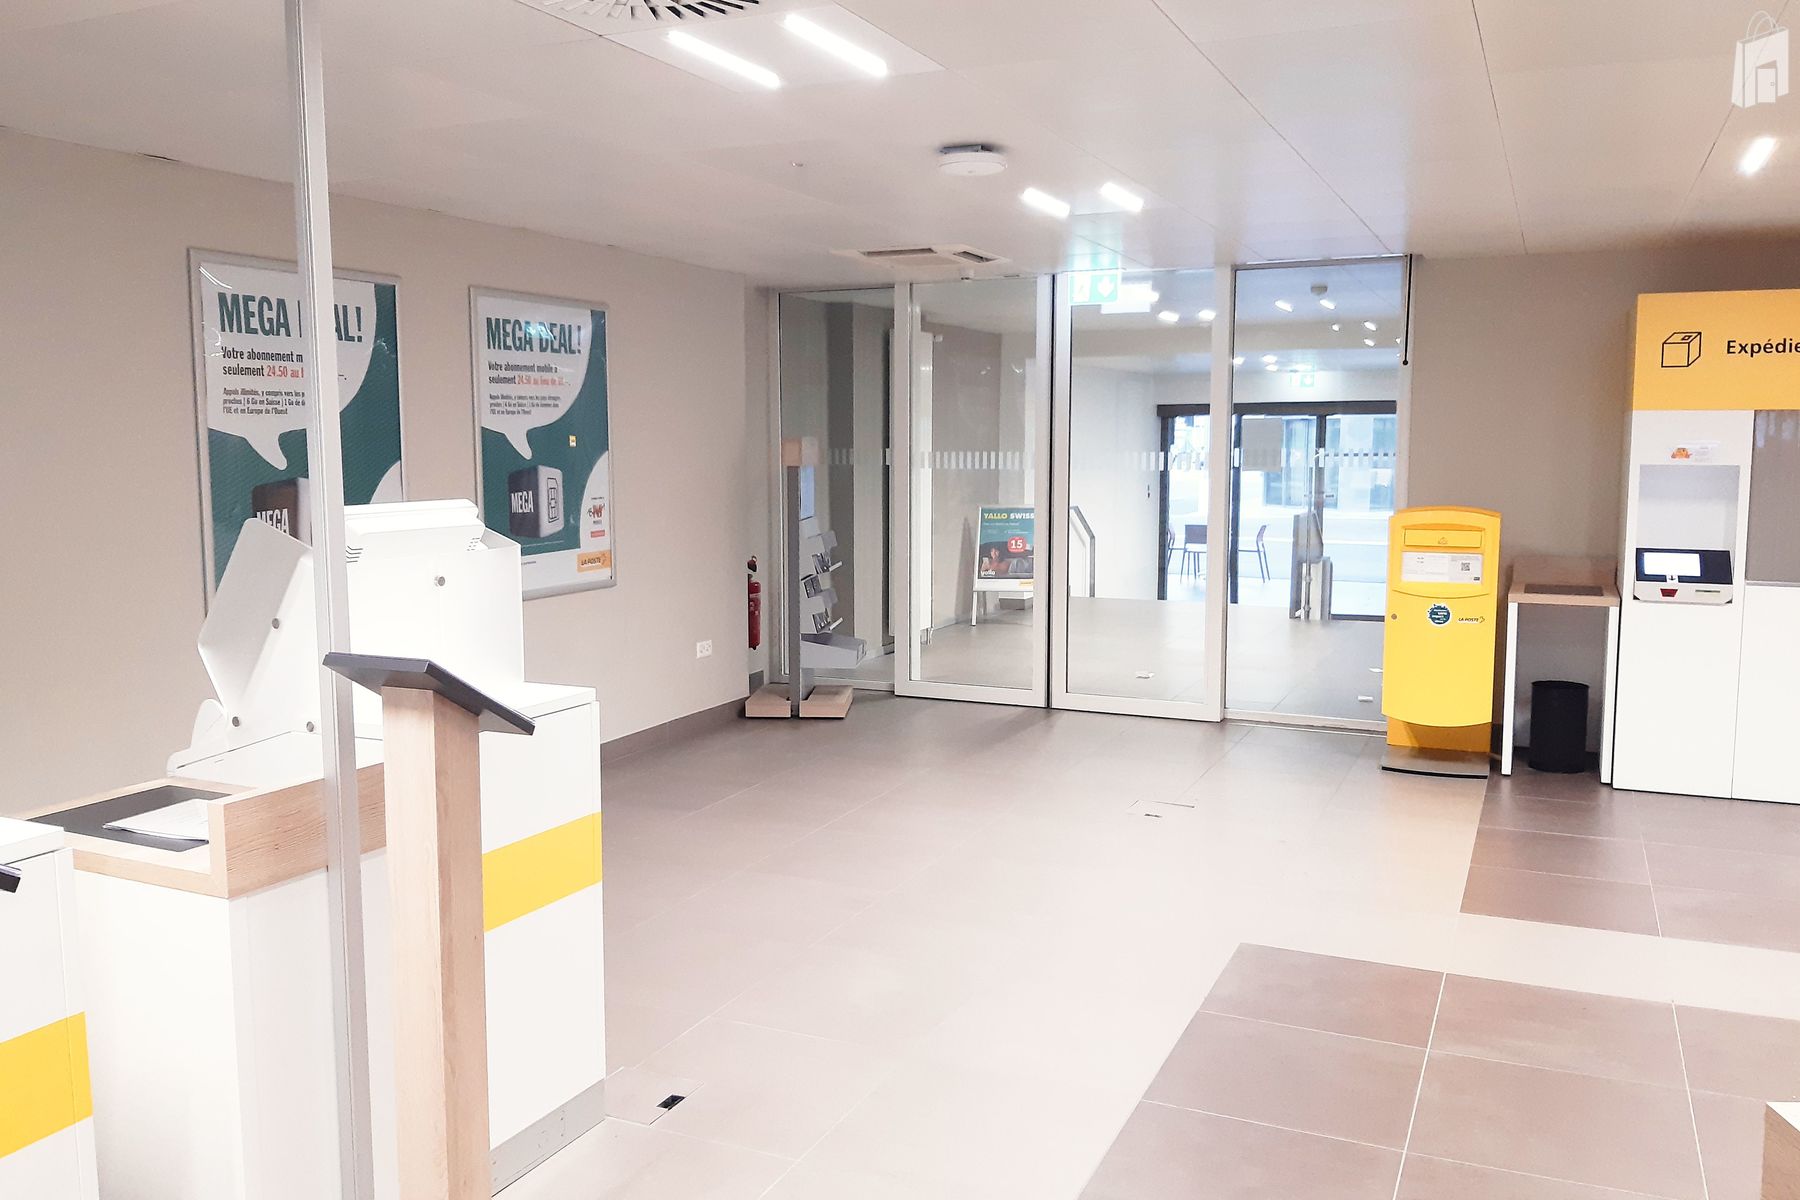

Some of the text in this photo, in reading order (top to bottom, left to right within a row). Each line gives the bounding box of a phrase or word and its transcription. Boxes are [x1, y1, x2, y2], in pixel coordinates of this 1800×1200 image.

[217, 292, 291, 337] MEGA
[486, 317, 581, 355] MEGA DEAL!
[221, 346, 244, 359] Votre
[247, 348, 294, 363] abonnement
[222, 363, 264, 376] seulement
[266, 365, 288, 378] 24.50
[290, 369, 299, 378] au
[488, 360, 503, 371] Votre
[489, 374, 516, 385] seulement
[511, 491, 534, 513] MEGA
[1010, 539, 1023, 549] 15
